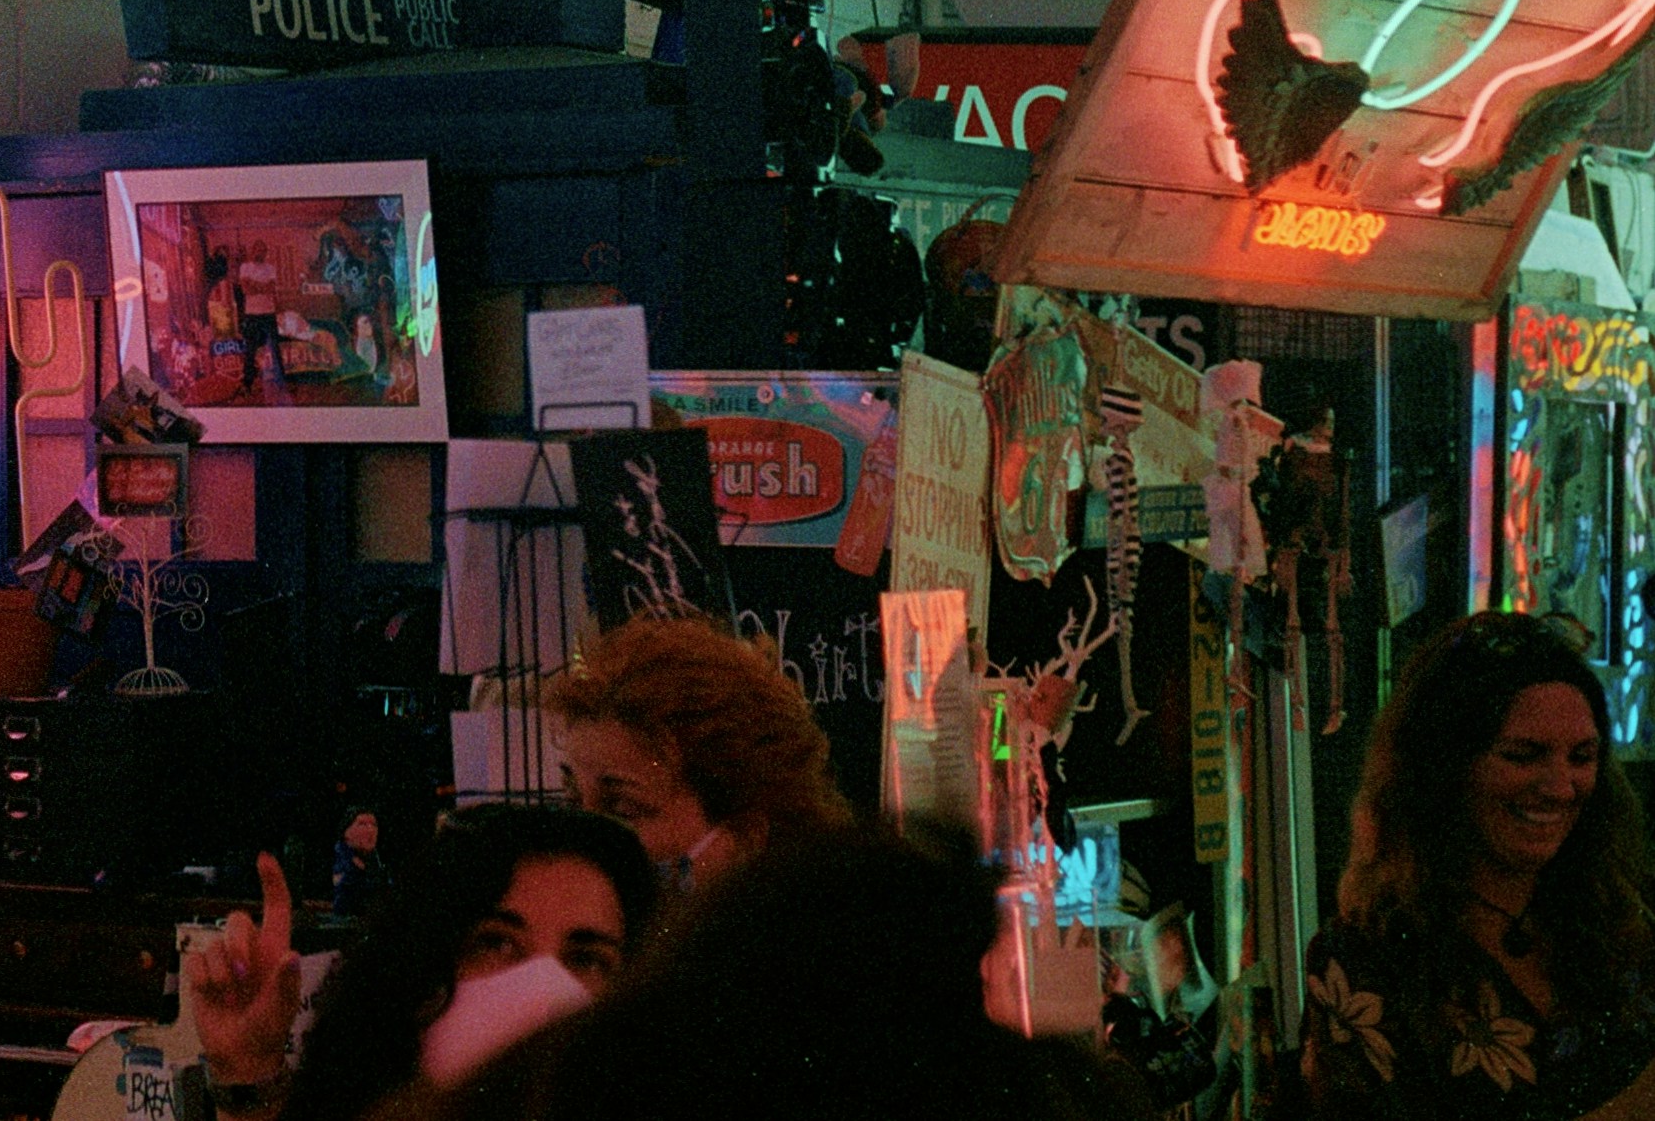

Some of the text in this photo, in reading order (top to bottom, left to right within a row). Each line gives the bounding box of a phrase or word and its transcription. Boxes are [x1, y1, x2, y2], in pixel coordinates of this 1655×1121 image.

[407, 20, 455, 50] CALL
[930, 403, 968, 471] NO
[709, 441, 818, 497] ush
